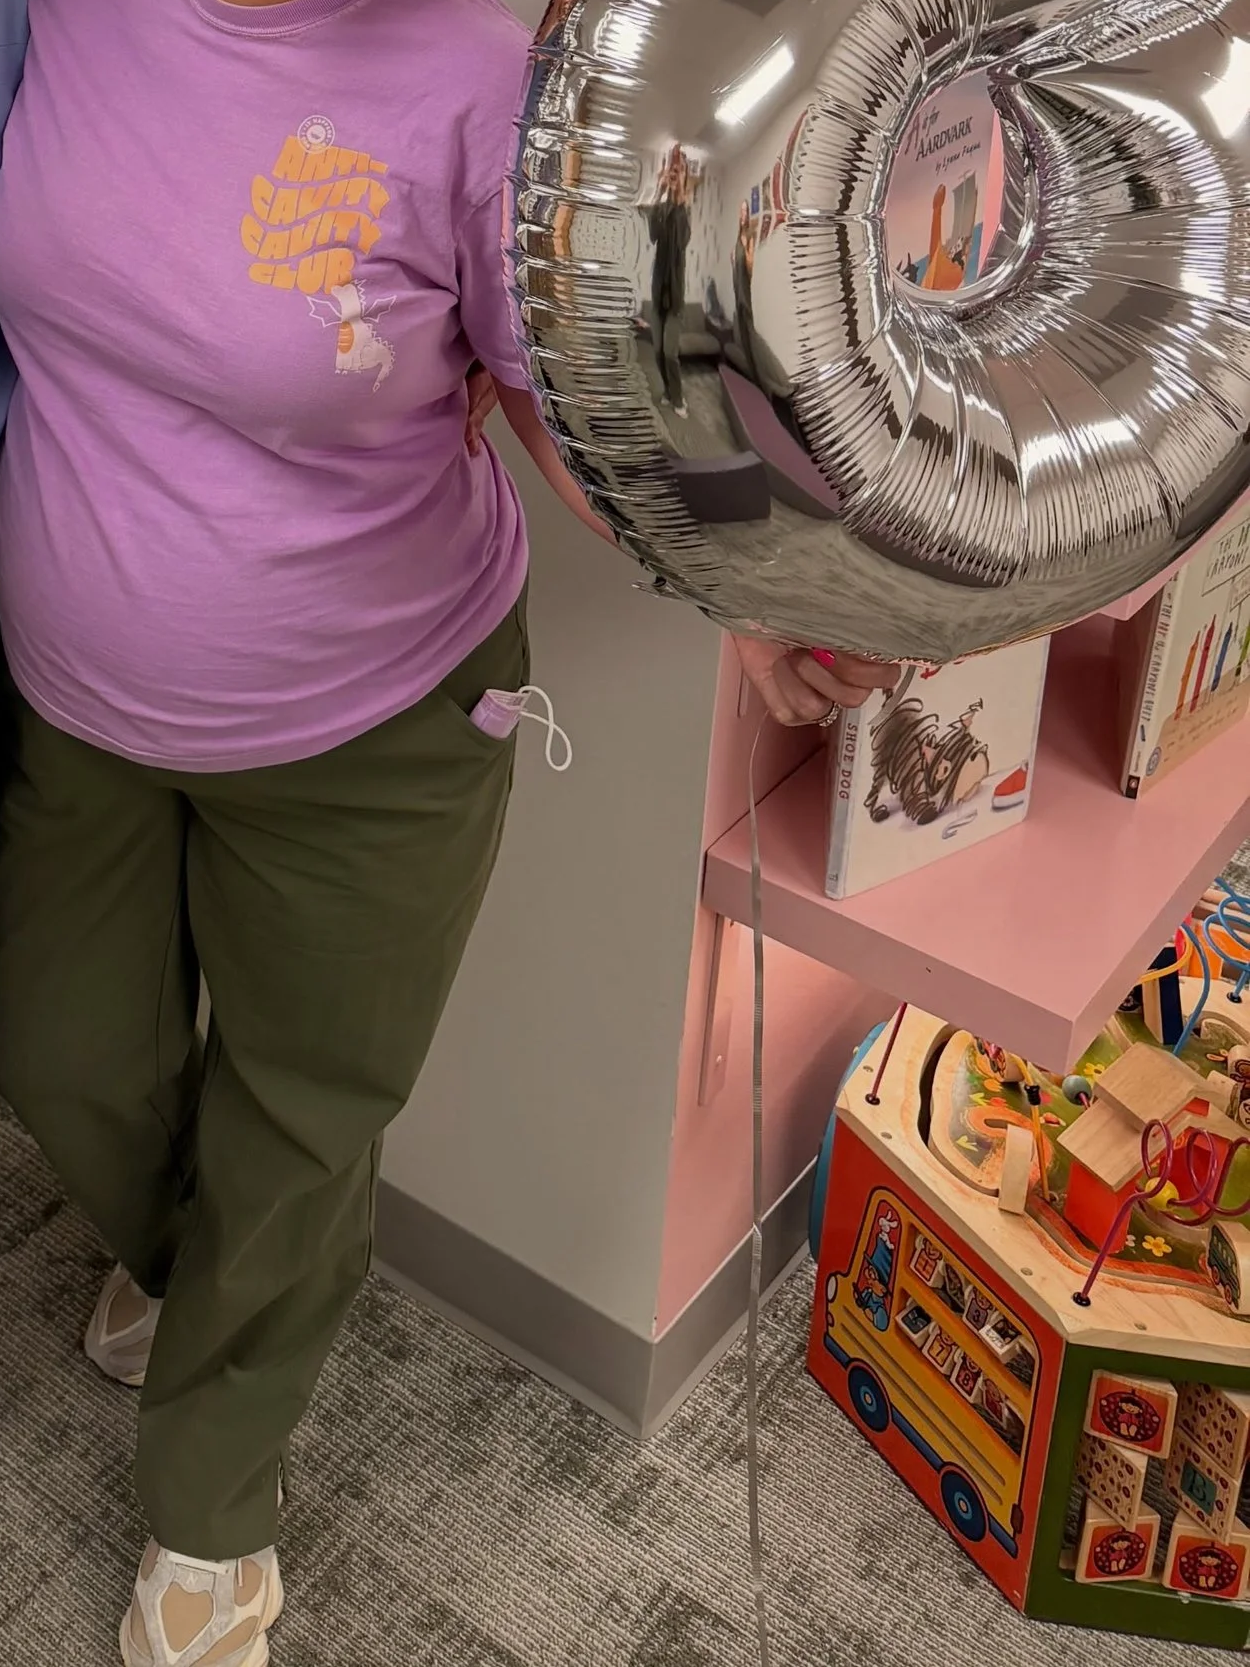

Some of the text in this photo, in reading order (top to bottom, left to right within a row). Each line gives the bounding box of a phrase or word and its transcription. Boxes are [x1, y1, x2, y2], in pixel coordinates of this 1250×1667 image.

[272, 135, 388, 182] ANTI-
[915, 116, 973, 162] AARDVARK
[252, 174, 391, 226] CAVITY
[239, 211, 382, 260] CAVITY
[248, 246, 356, 295] CLUB
[838, 722, 858, 799] SHOE DOG
